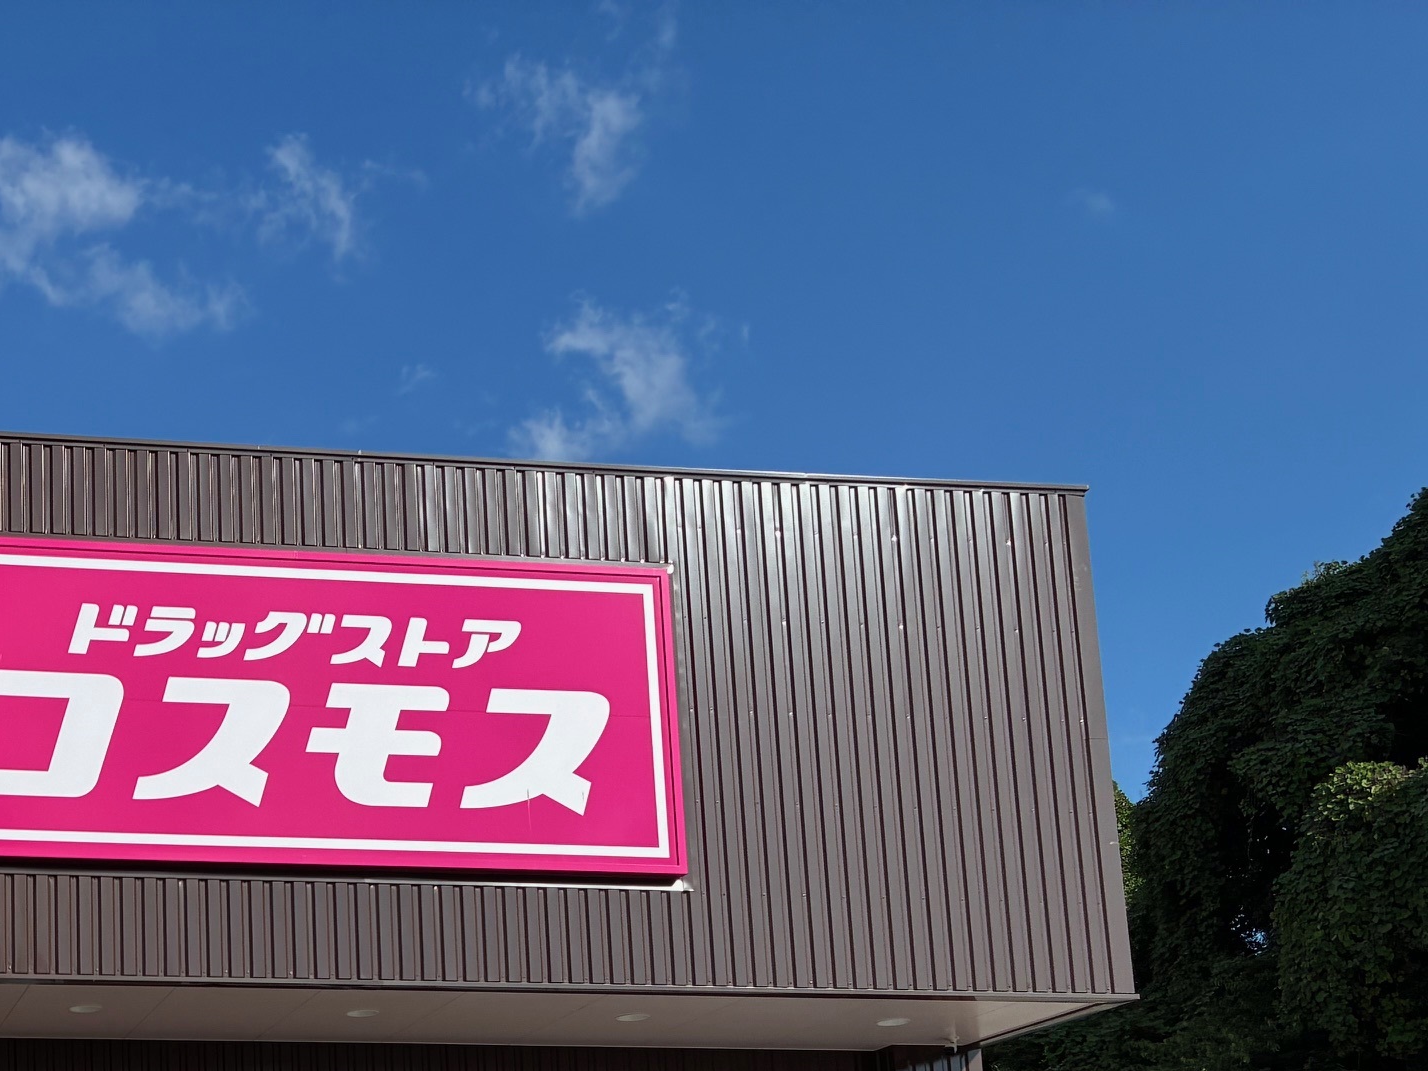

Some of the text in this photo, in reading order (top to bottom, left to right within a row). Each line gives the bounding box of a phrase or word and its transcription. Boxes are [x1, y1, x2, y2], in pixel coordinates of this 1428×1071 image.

[67, 602, 521, 669] ドラッグストア
